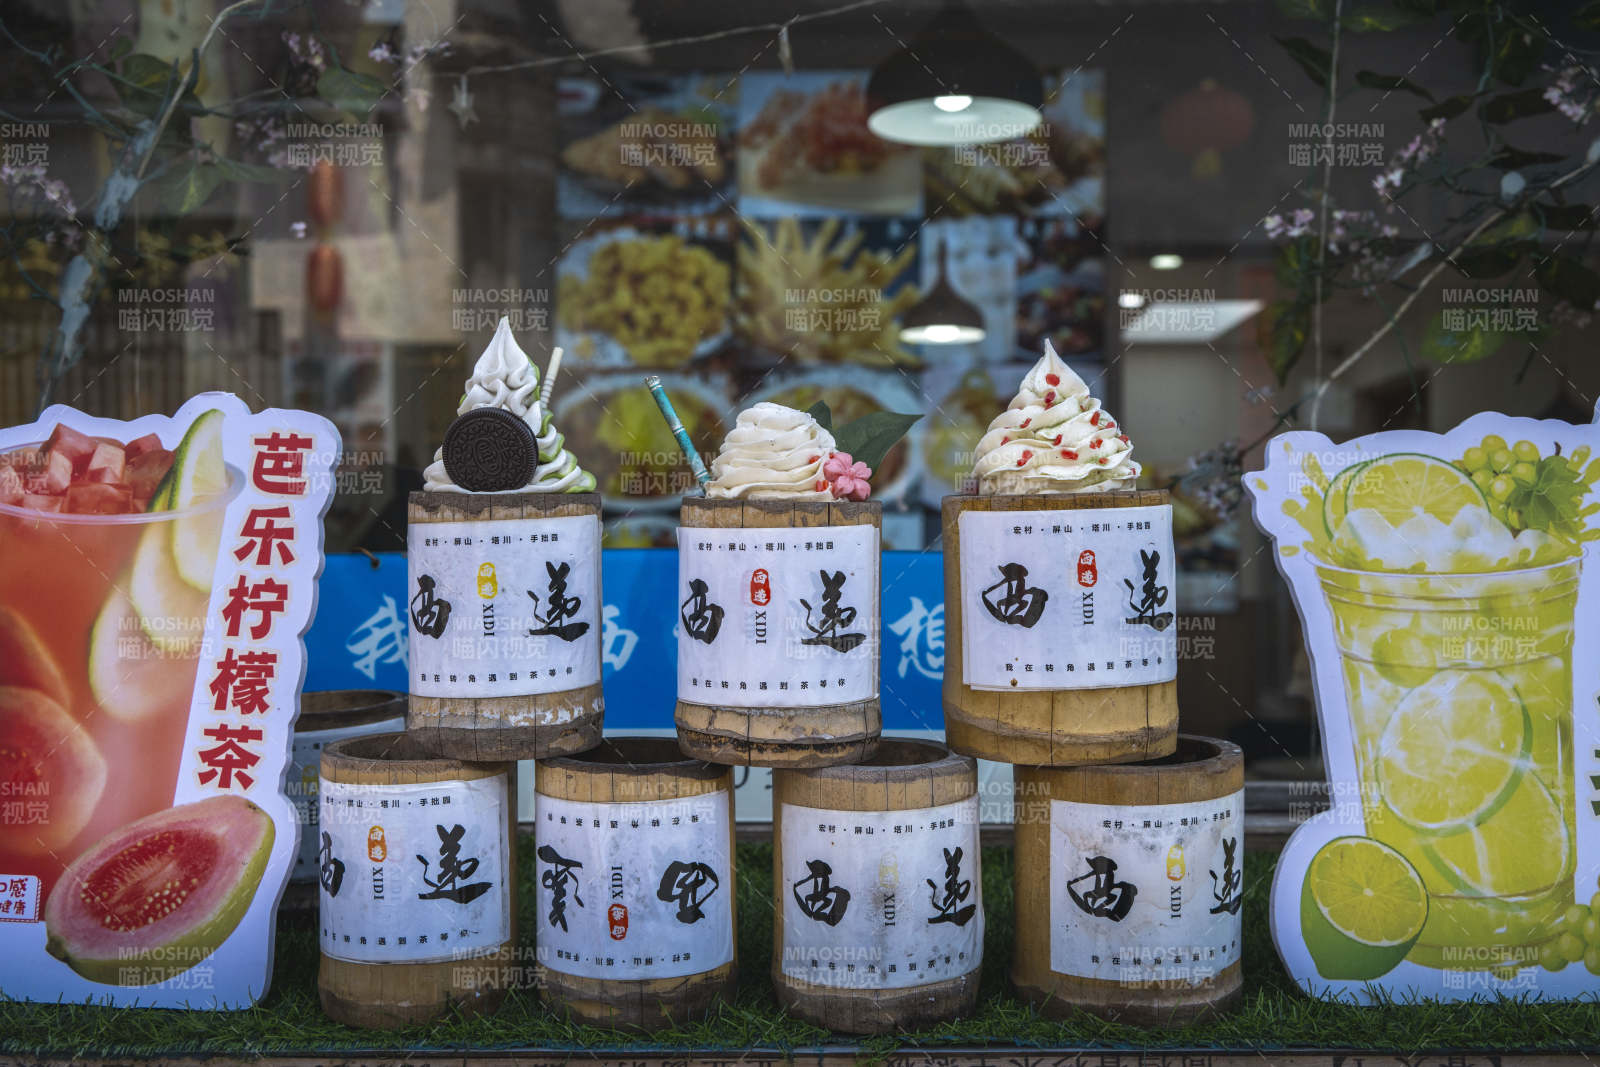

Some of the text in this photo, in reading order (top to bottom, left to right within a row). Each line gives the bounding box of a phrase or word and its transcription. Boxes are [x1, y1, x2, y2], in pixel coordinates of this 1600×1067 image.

[198, 432, 313, 790] 芭乐柠檬茶
[982, 563, 1048, 629] 西
[1083, 592, 1094, 625] XIDI
[483, 604, 494, 636] XIDI
[756, 611, 767, 644] XIDI
[373, 867, 384, 900] XIDI
[612, 866, 623, 899] XIDI
[793, 860, 851, 927] 西
[1067, 856, 1138, 922] 西
[884, 894, 896, 926] XIDI
[1170, 886, 1181, 919] XIDI
